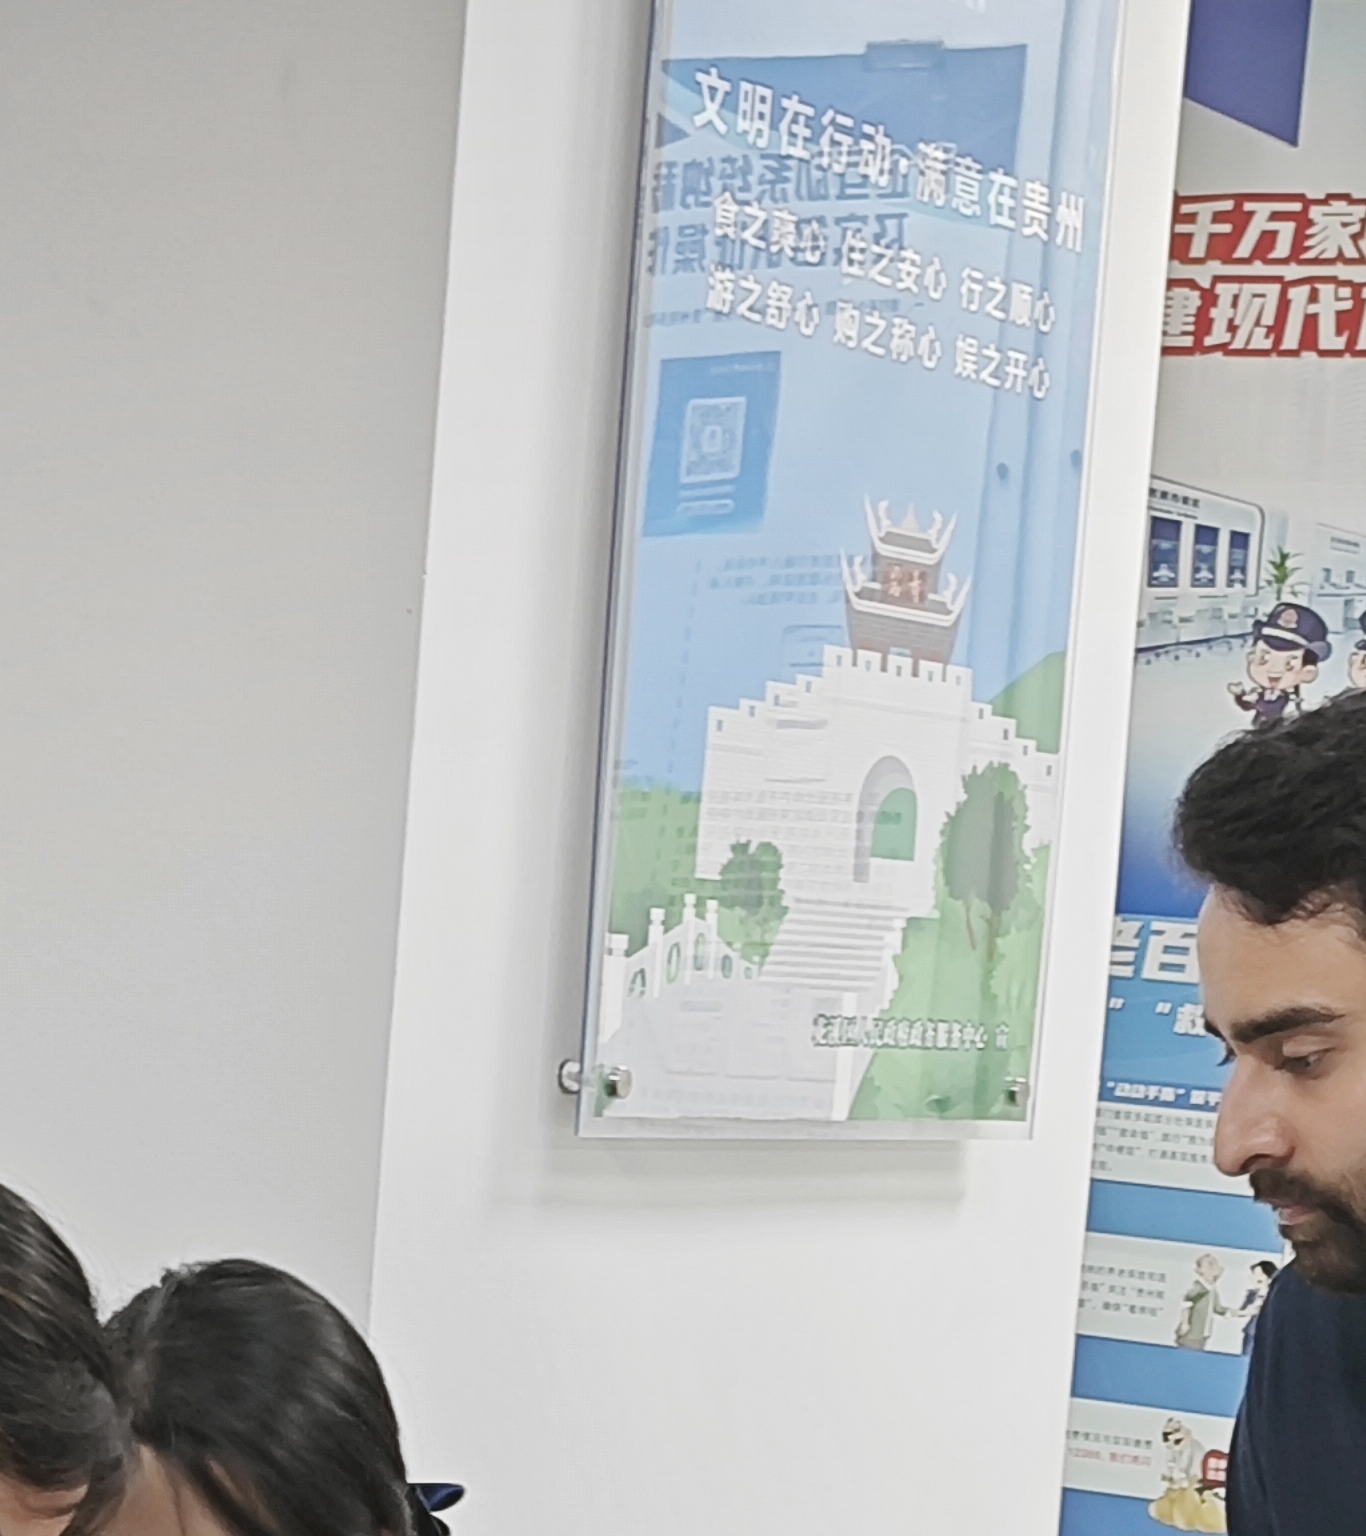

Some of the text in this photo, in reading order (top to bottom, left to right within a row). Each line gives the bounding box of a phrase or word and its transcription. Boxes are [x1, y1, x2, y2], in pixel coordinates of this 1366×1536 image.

[706, 263, 1051, 400] 游之舒心 购之称心 娱之开心
[840, 230, 948, 300] 住之安心
[960, 266, 1057, 334] 行之顺心
